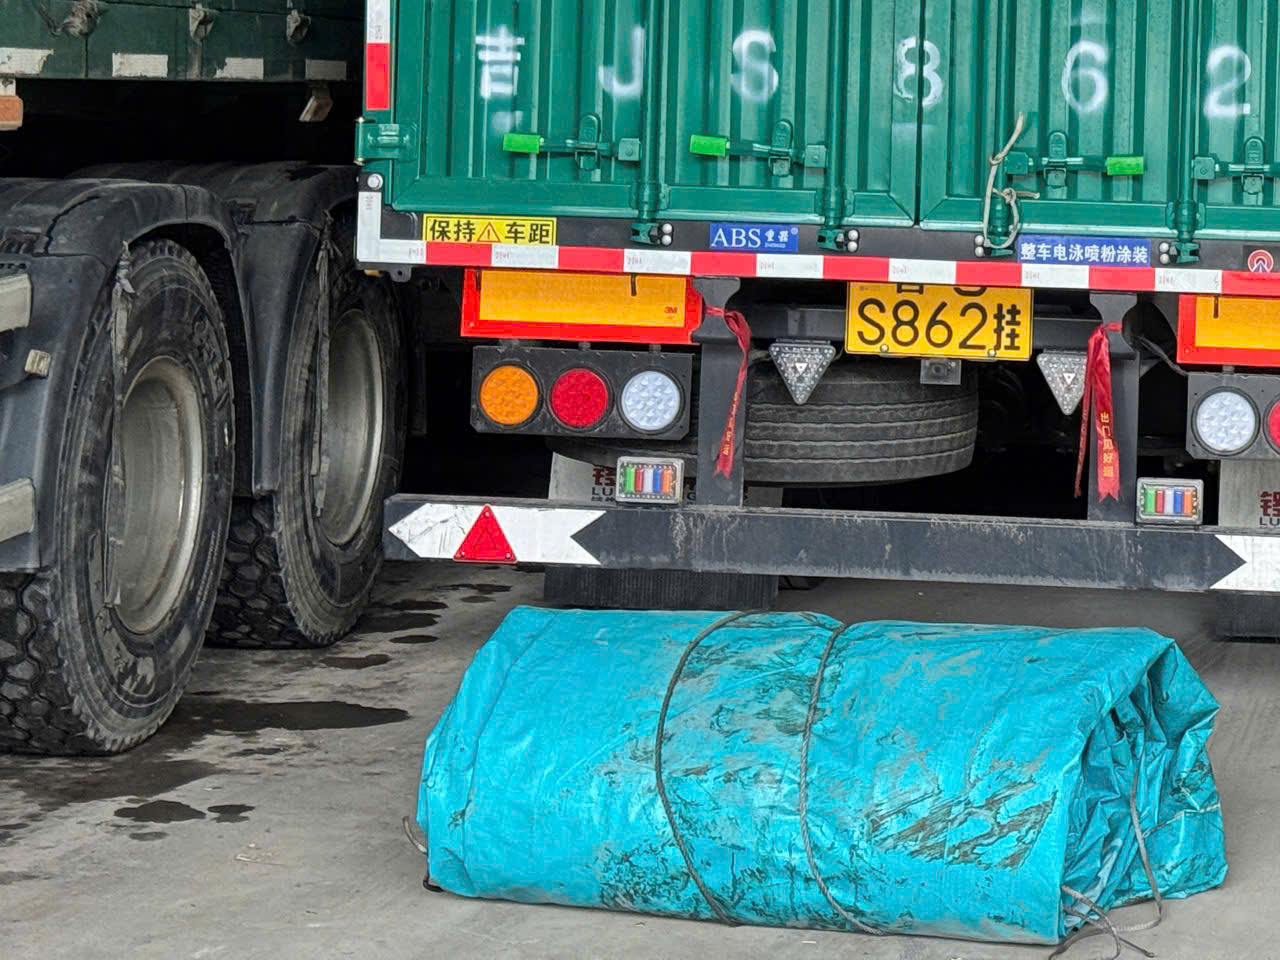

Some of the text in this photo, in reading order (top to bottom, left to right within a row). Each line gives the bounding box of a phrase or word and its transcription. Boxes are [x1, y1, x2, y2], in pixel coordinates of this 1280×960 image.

[429, 219, 551, 244] 保持 车距
[711, 227, 761, 248] ABS
[1020, 242, 1148, 264] 整车电泳喷粉涂装
[857, 297, 1021, 351] S862挂
